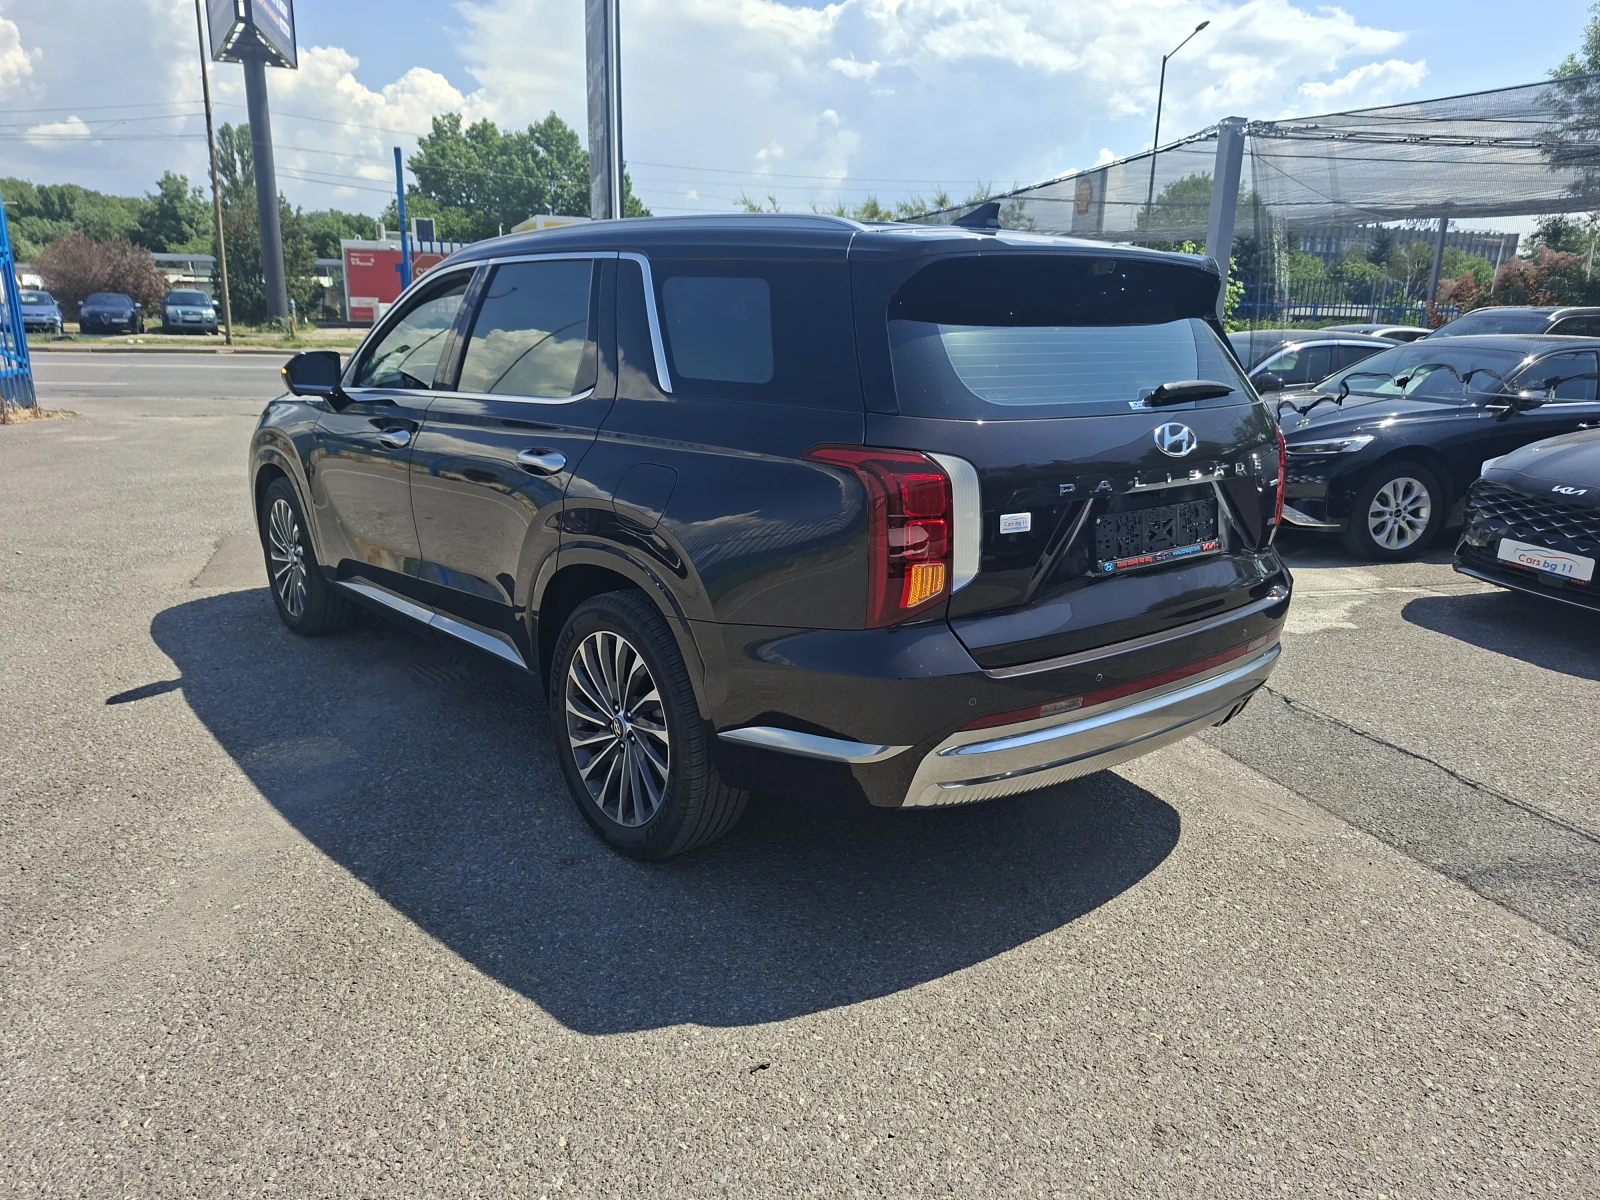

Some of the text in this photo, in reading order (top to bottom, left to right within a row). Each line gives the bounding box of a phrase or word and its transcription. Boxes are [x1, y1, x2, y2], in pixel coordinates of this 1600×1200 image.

[1518, 553, 1541, 567] Cars
[1542, 559, 1558, 571] bg
[1561, 563, 1573, 573] 11
